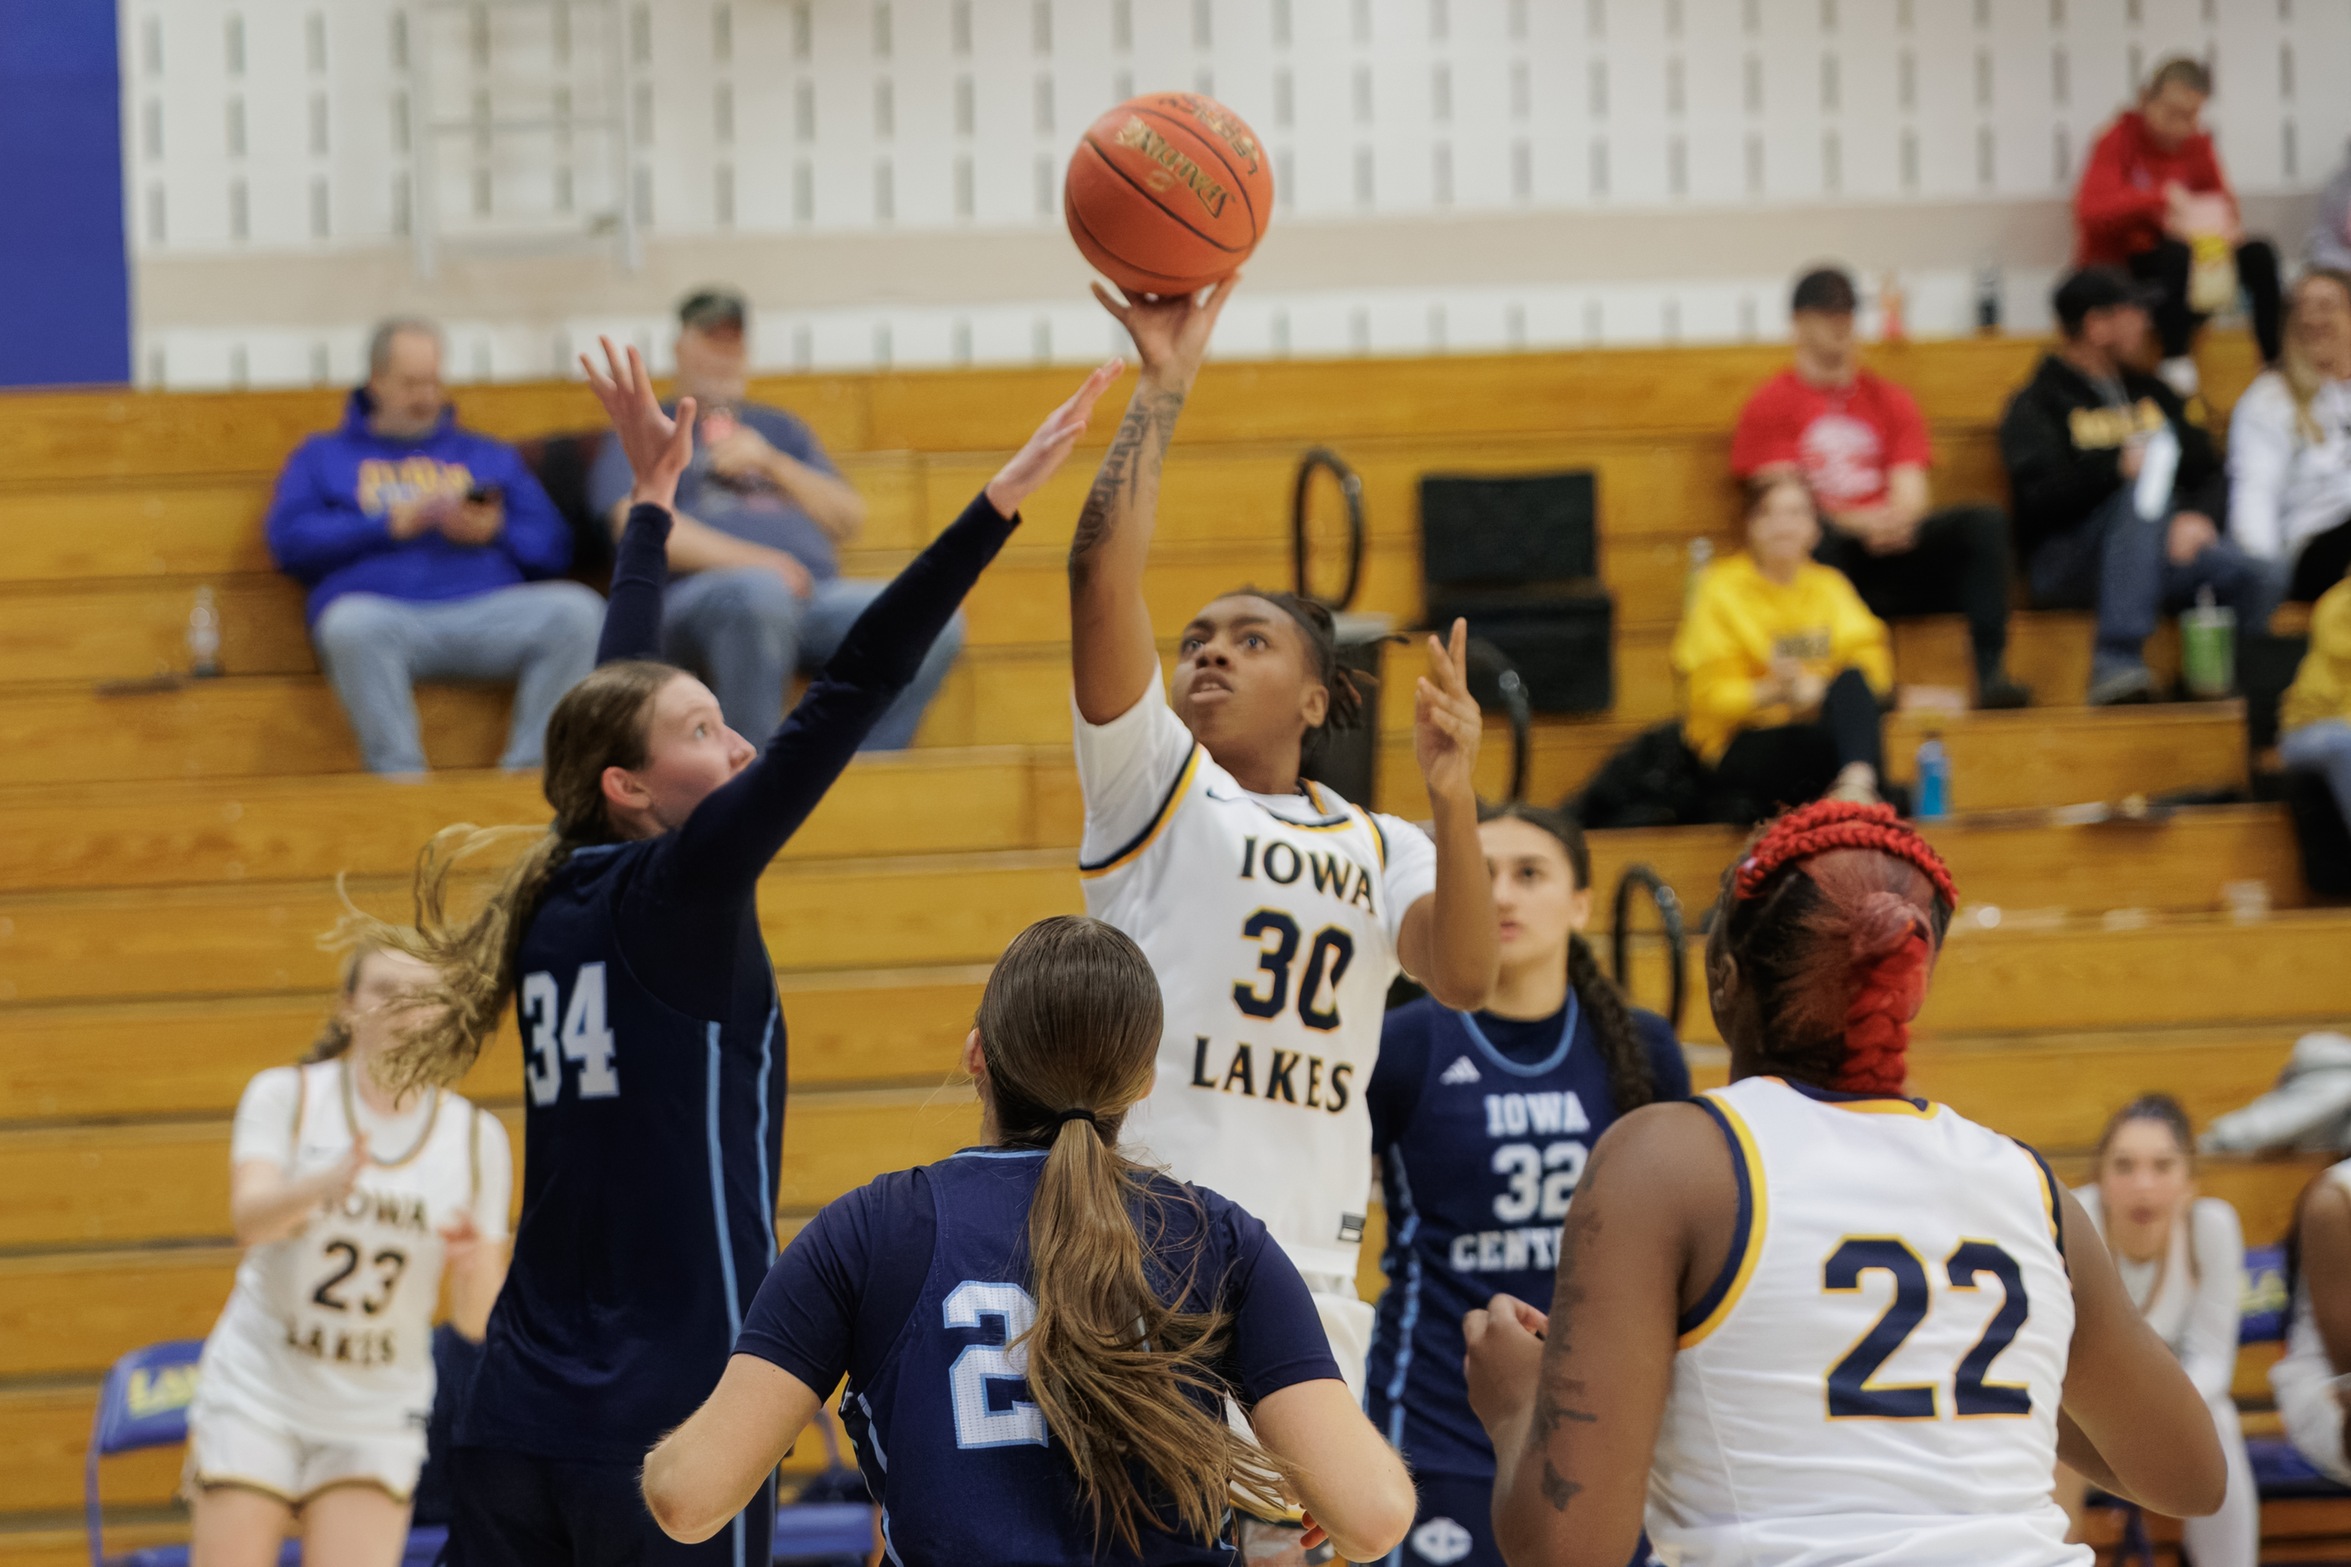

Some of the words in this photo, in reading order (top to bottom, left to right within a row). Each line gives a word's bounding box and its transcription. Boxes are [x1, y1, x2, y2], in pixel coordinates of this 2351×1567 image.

[1240, 834, 1376, 916] IOWA
[1231, 905, 1355, 1034] 30
[523, 961, 621, 1107] 34
[1190, 1034, 1354, 1113] LAKES
[1484, 1091, 1590, 1138] IOWA
[1491, 1141, 1589, 1223] 32
[311, 1239, 408, 1316] 23
[1452, 1227, 1564, 1273] CENT
[1821, 1233, 2032, 1423] 22
